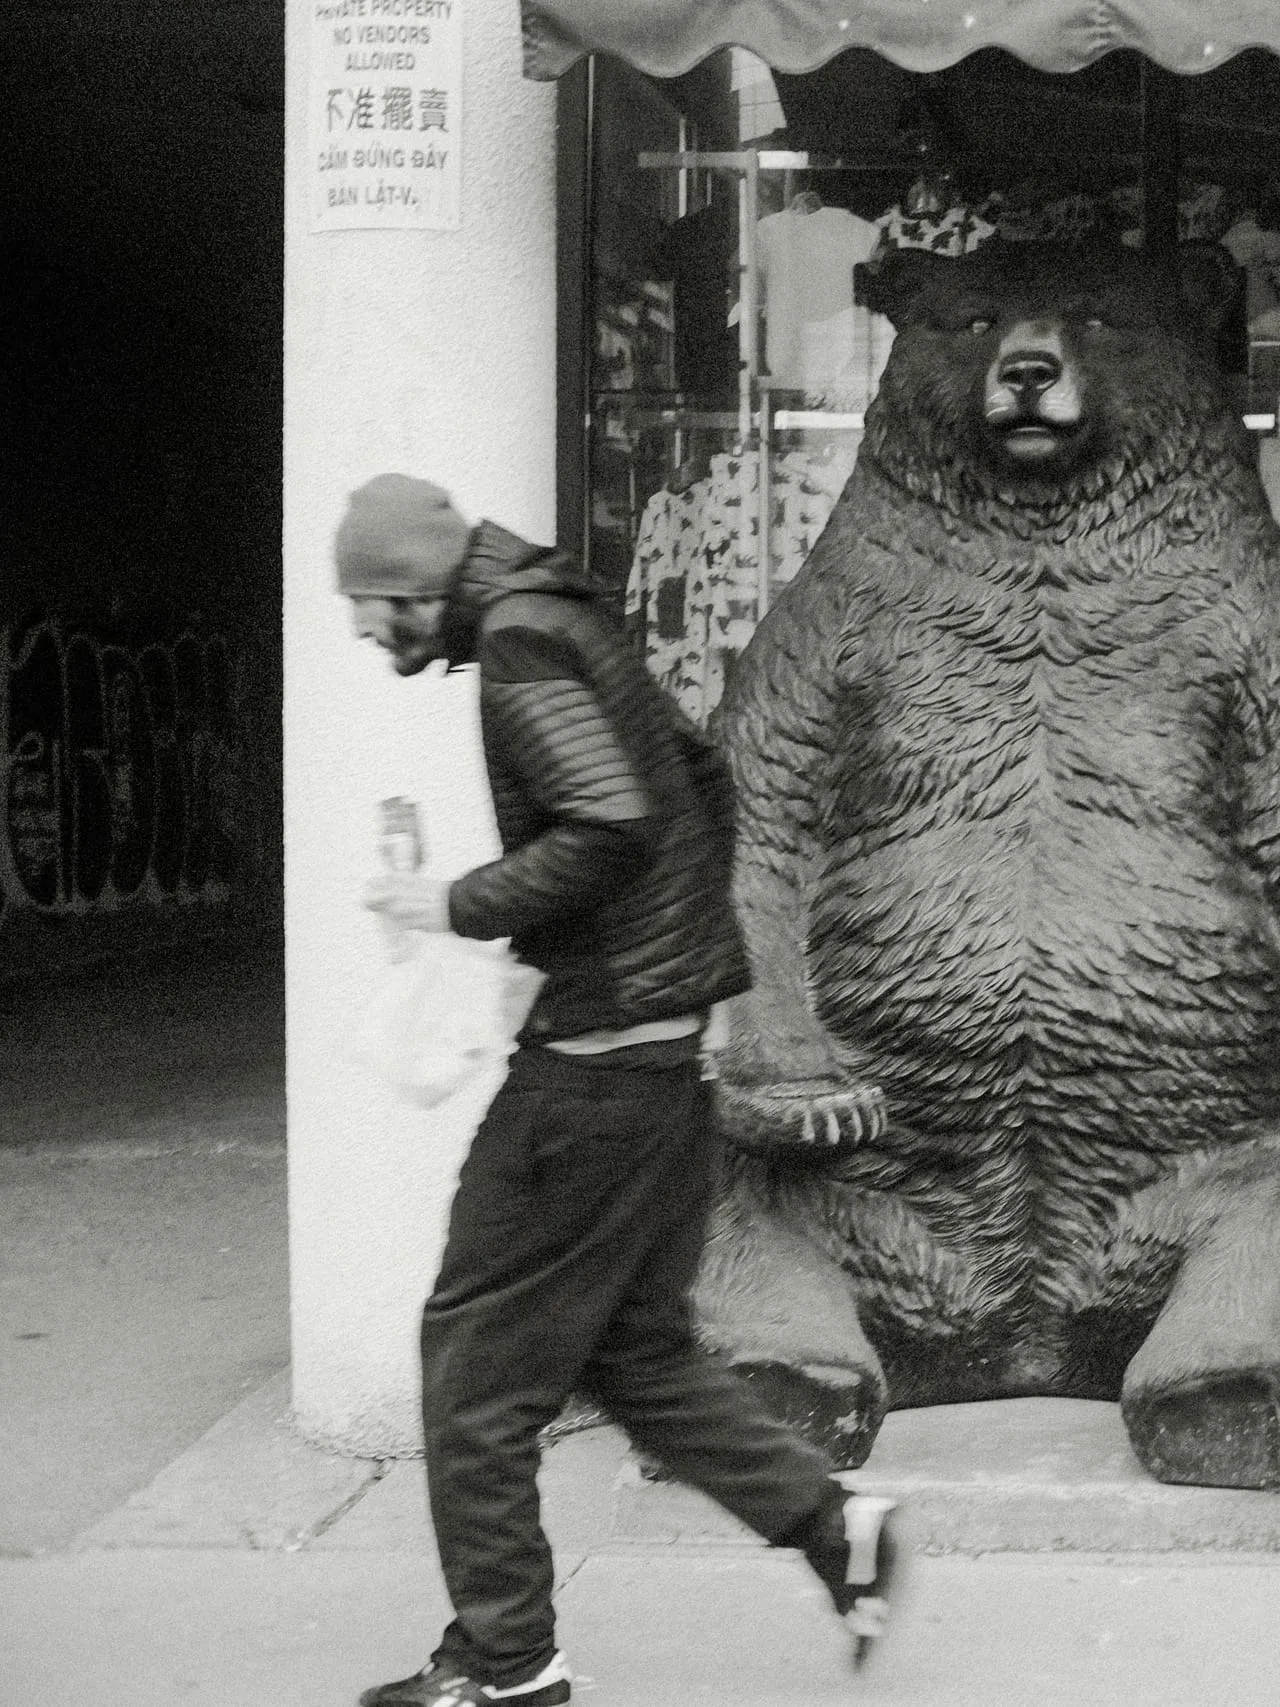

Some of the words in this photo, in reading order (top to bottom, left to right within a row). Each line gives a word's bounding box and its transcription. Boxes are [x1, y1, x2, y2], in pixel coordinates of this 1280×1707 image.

[315, 0, 367, 20] PRIVATE
[371, 0, 452, 19] PROPERTY
[333, 26, 352, 45] NO
[358, 24, 431, 44] VENDORS
[345, 52, 416, 71] ALLOWED
[326, 86, 449, 133] 不准擺賣
